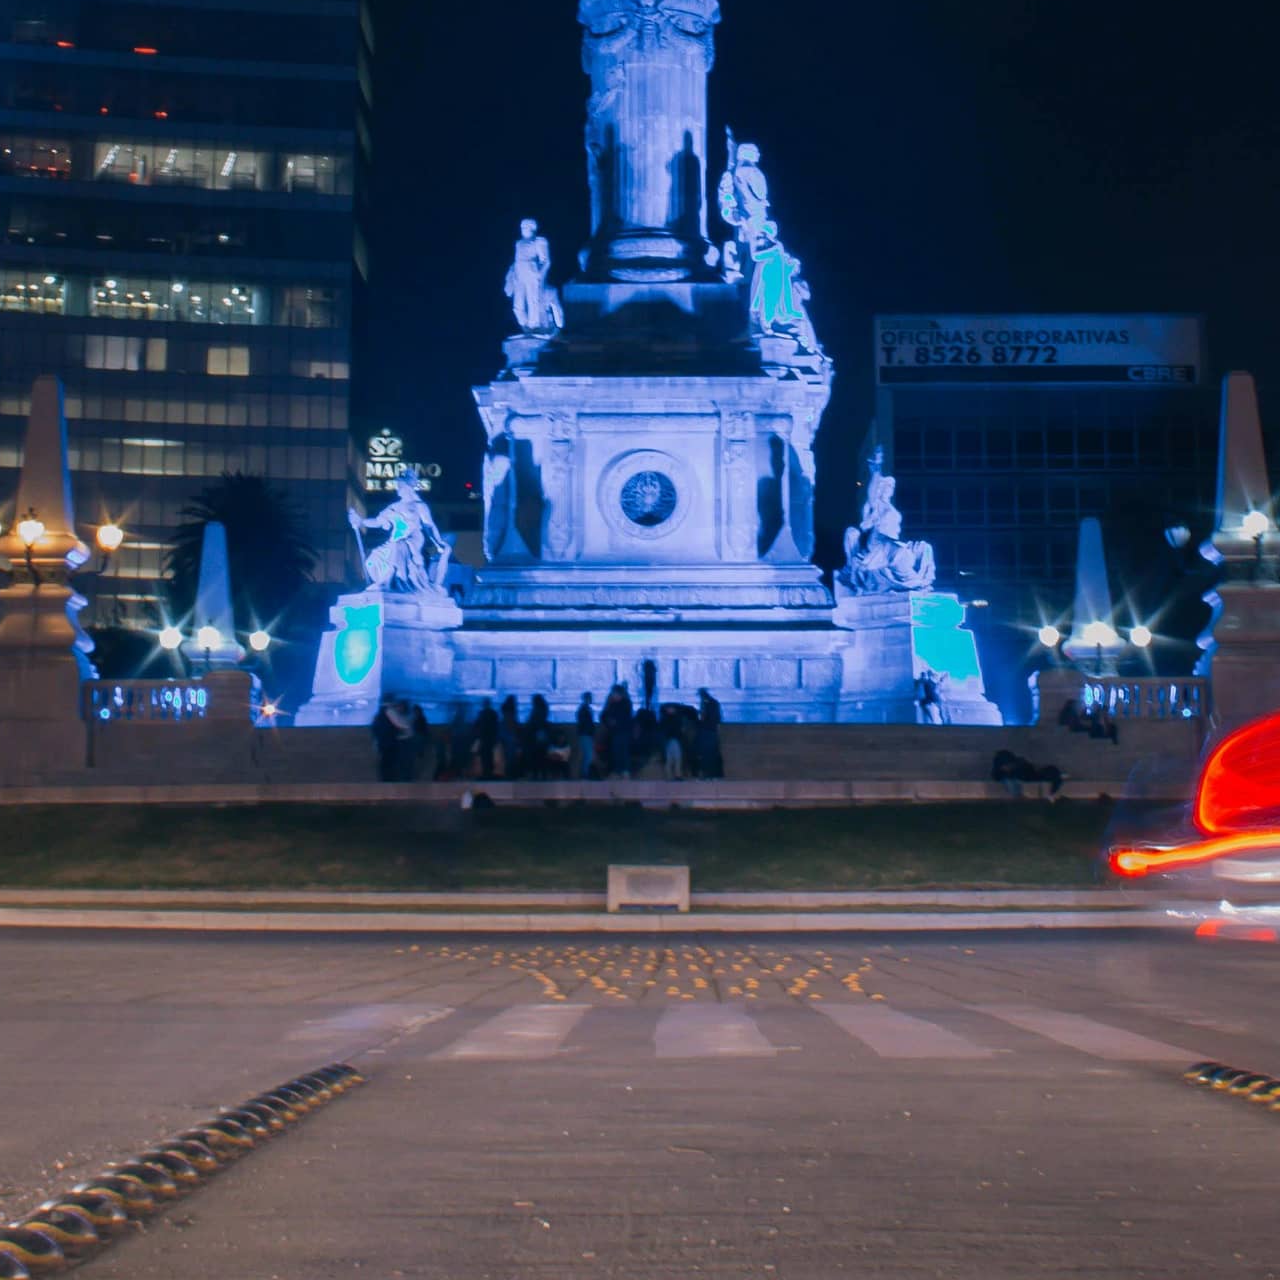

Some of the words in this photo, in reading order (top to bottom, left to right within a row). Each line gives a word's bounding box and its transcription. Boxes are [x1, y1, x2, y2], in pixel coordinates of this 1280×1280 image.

[880, 328, 976, 346] OFICINAS
[982, 328, 1130, 346] CORPORATIVAS
[881, 346, 906, 365] T.
[914, 345, 983, 365] 8526
[990, 345, 1058, 365] 8772
[1126, 365, 1187, 382] CBRE
